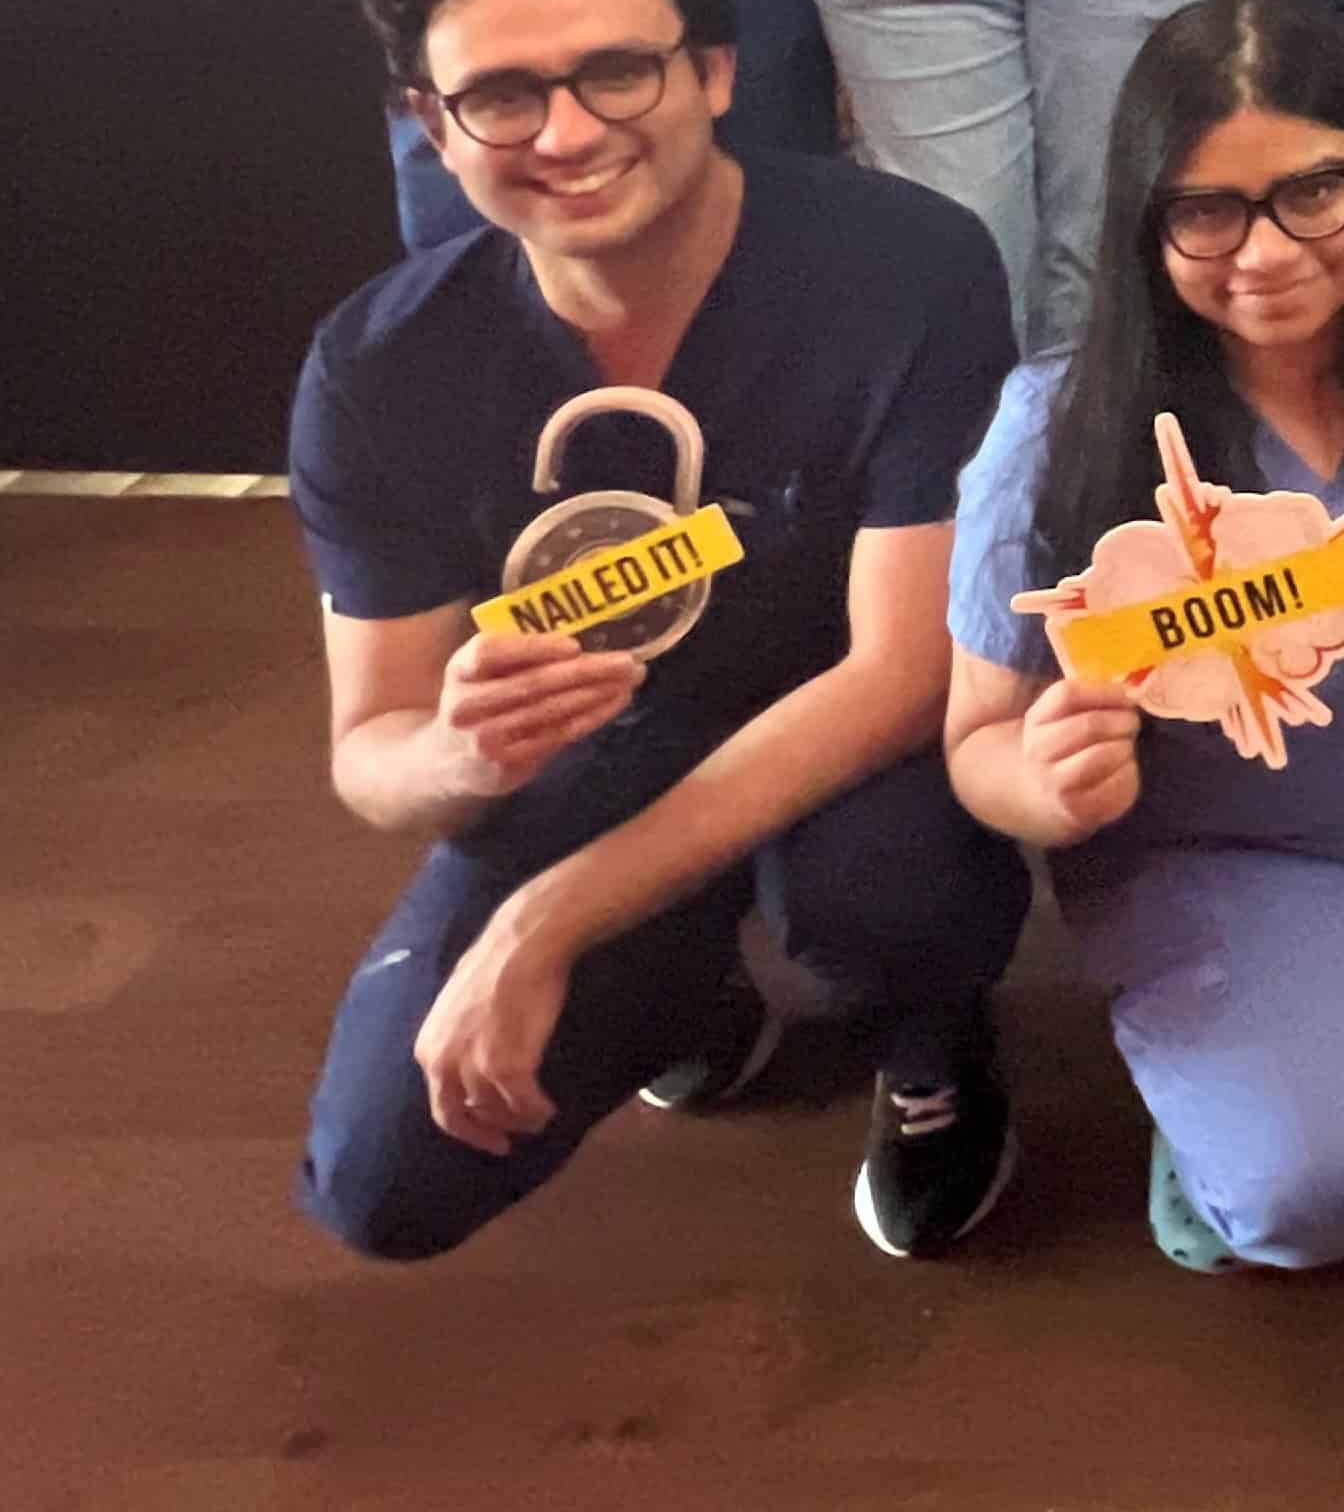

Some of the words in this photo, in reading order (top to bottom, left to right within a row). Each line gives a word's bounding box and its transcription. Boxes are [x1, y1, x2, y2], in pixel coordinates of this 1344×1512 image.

[509, 555, 650, 635] NAILED
[648, 531, 704, 582] IT!
[1150, 567, 1304, 651] BOOM!
